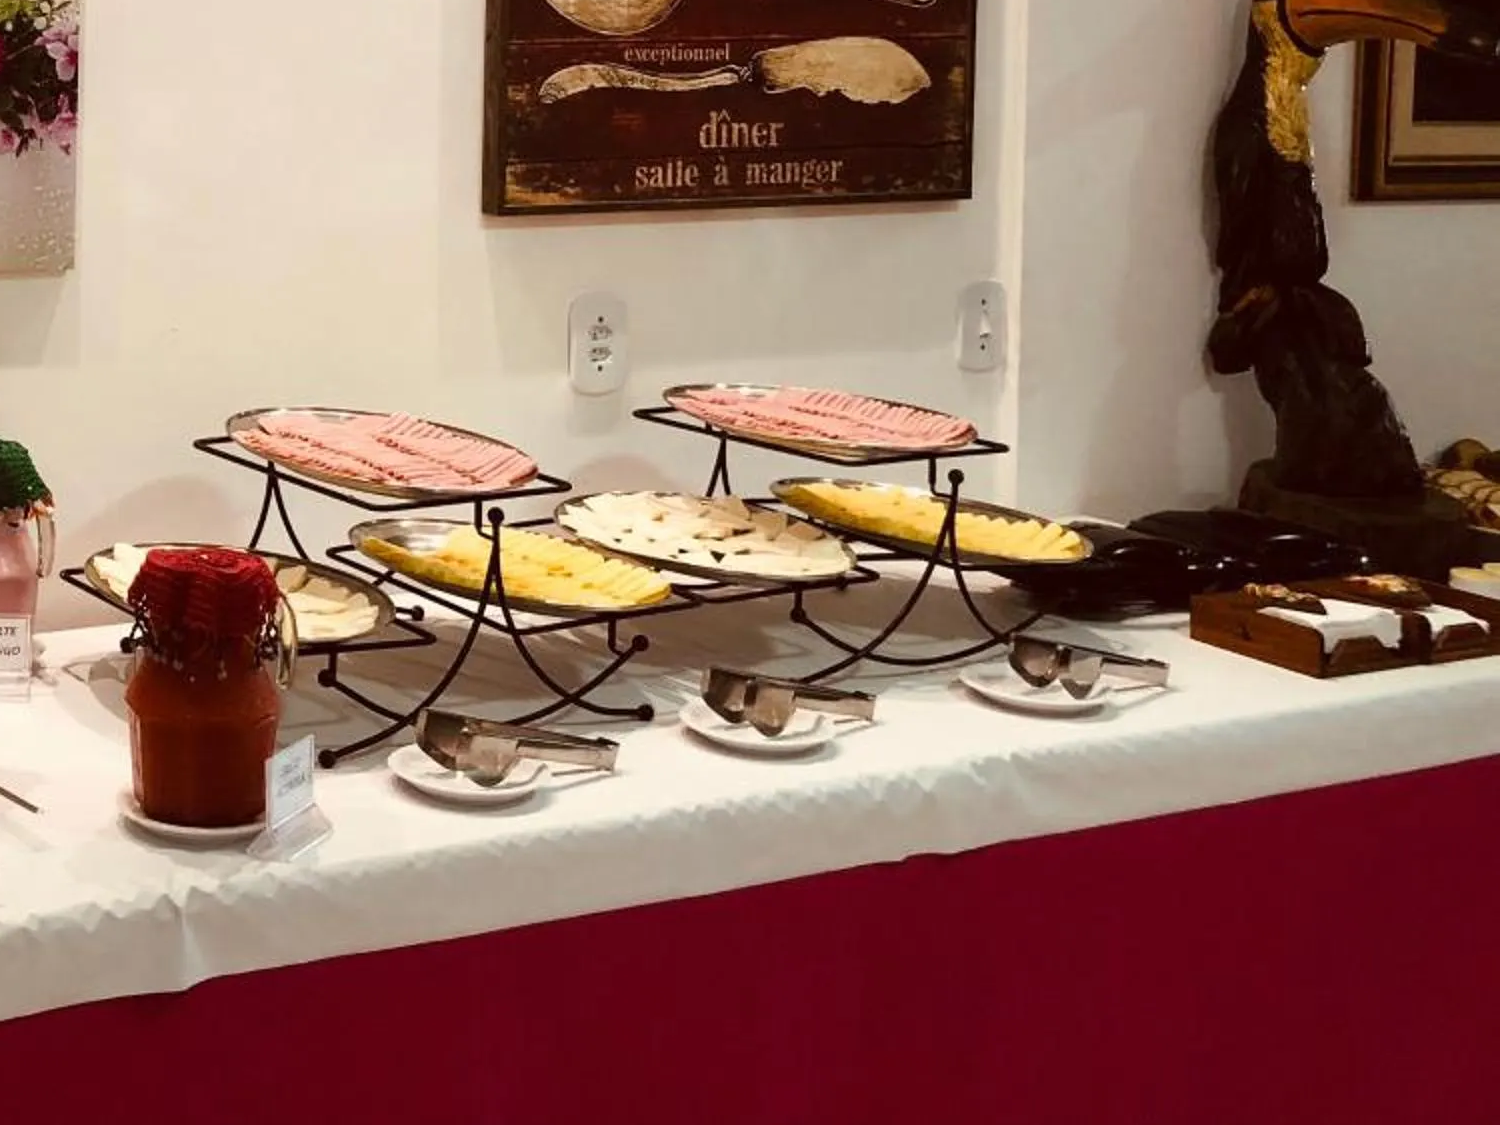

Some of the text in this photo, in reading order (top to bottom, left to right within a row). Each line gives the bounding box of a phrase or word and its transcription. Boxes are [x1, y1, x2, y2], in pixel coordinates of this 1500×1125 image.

[624, 43, 730, 66] exceptionnel
[699, 108, 785, 149] dîner
[634, 155, 844, 189] salle à manger
